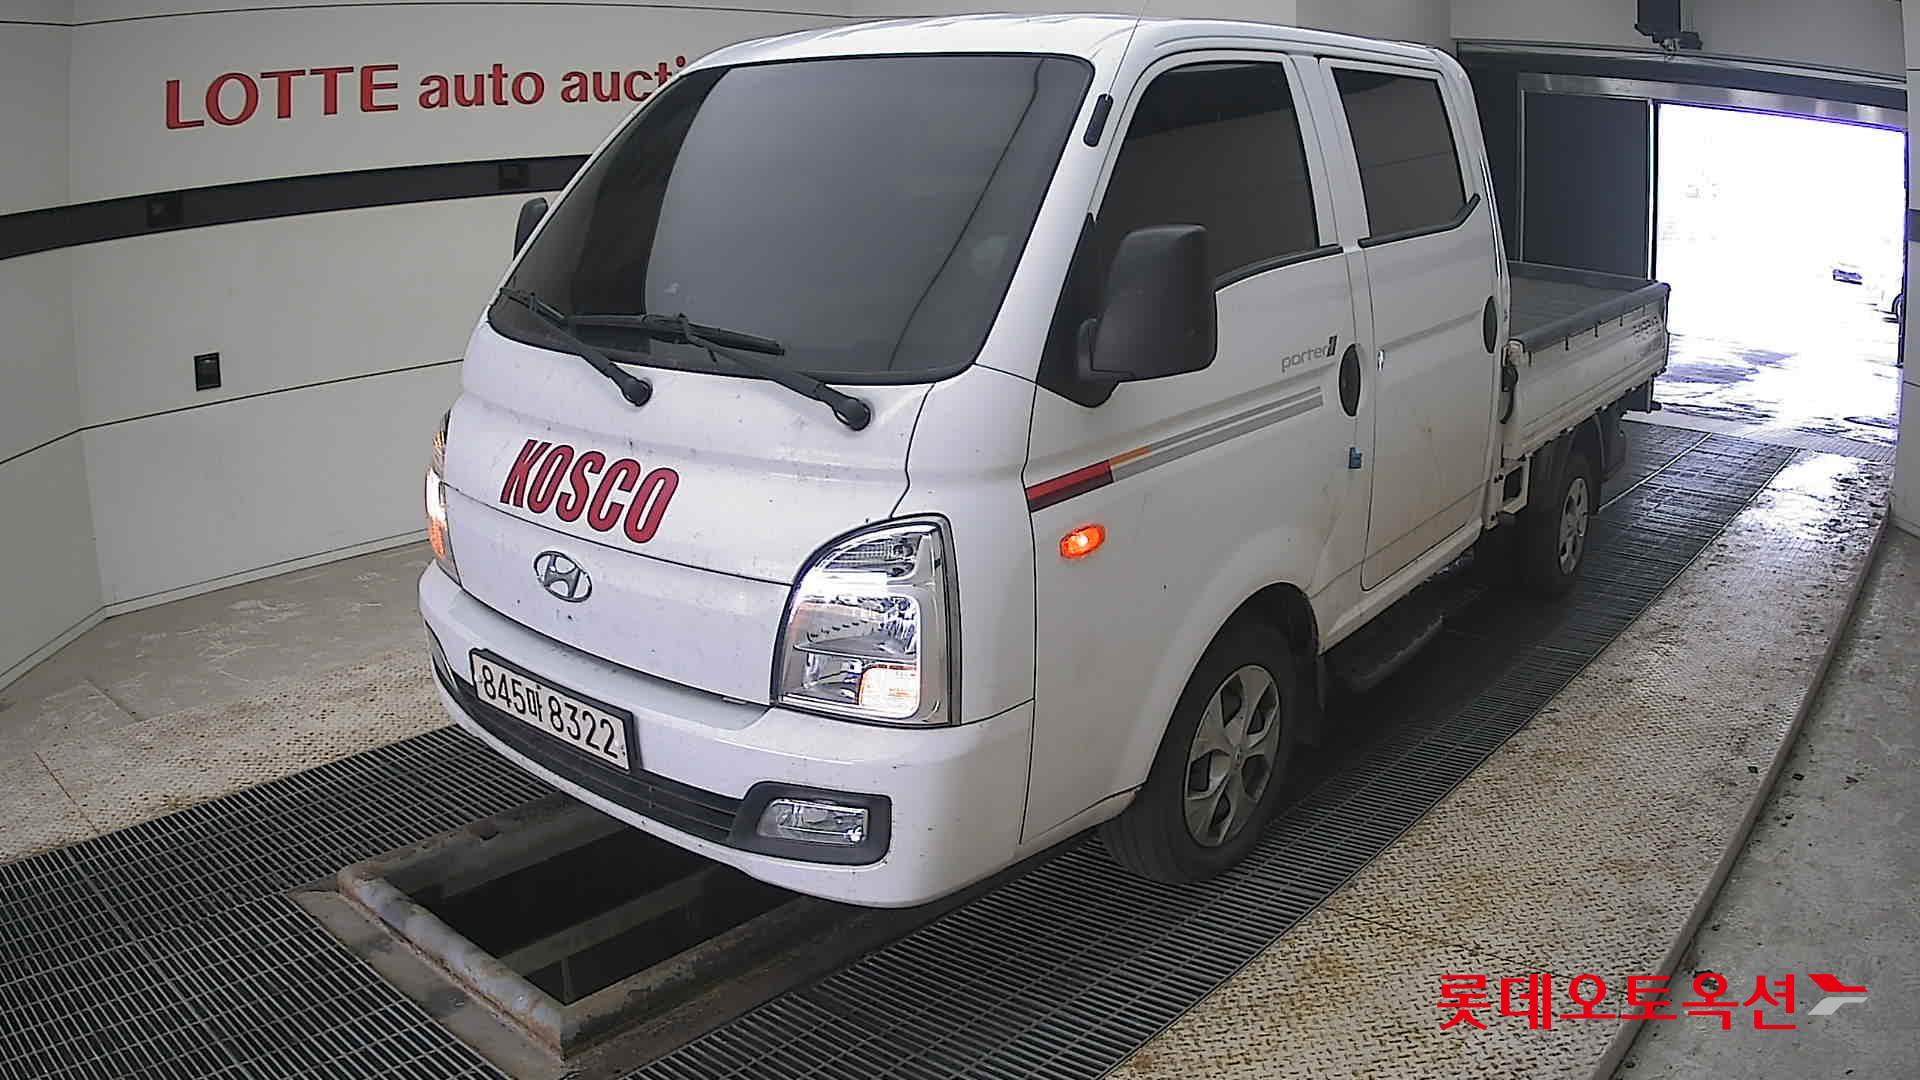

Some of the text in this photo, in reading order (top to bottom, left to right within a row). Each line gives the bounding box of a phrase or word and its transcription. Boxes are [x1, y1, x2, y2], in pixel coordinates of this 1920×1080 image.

[165, 55, 686, 130] LOTTE auto auct
[499, 438, 680, 544] KOSCO
[482, 664, 618, 759] 845마 8322
